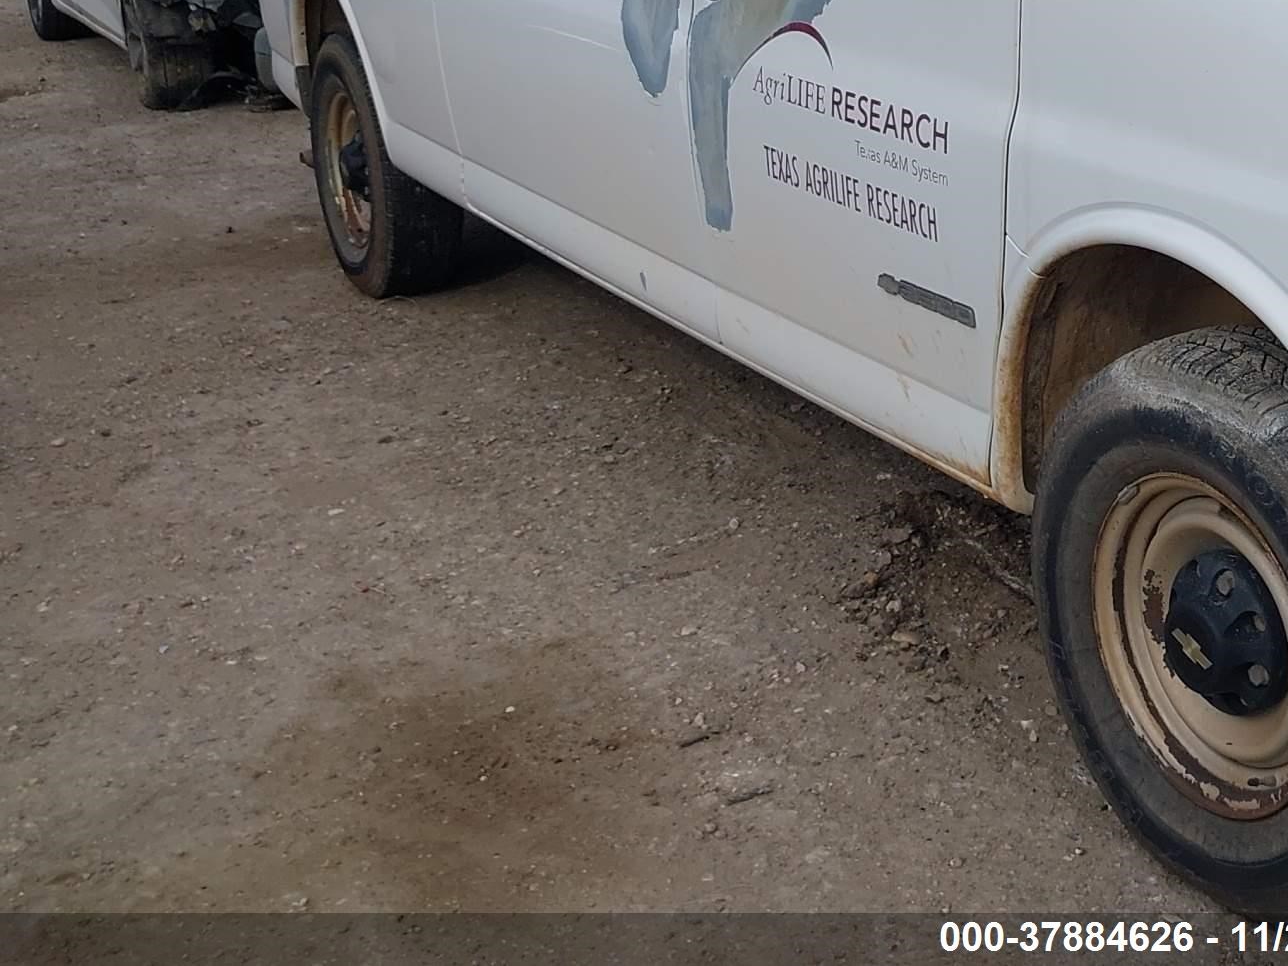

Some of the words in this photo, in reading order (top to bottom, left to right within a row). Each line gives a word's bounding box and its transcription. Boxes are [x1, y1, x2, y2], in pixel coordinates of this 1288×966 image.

[753, 66, 826, 114] AgriLIFE
[831, 86, 949, 154] RESEARCH
[763, 145, 800, 188] TEXAS
[805, 161, 862, 213] AGRILIFE
[866, 183, 938, 242] RESEARCH
[884, 150, 909, 171] A&M
[911, 159, 949, 187] System
